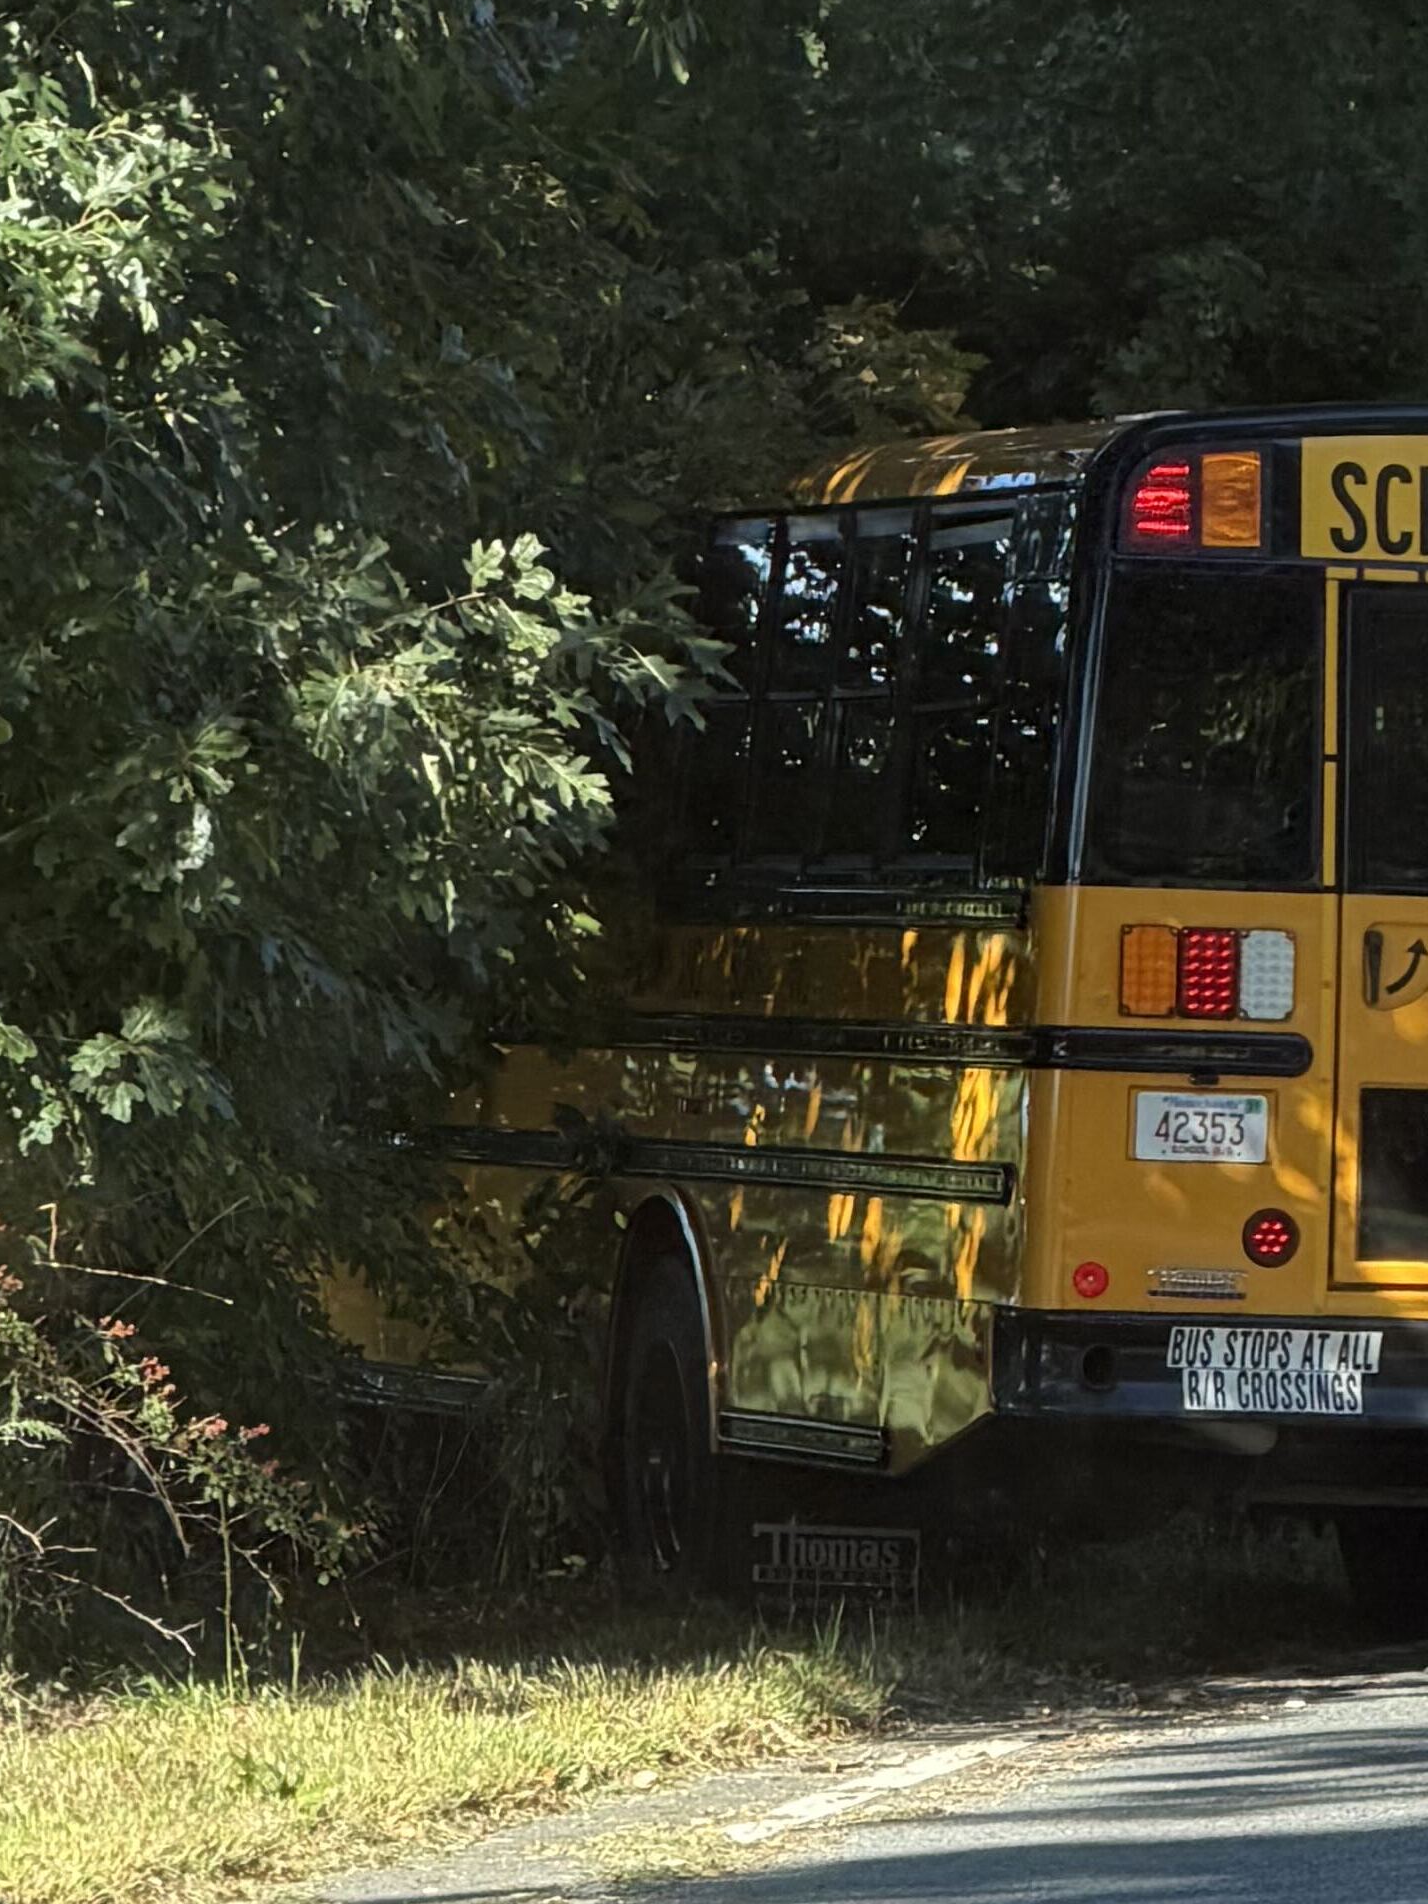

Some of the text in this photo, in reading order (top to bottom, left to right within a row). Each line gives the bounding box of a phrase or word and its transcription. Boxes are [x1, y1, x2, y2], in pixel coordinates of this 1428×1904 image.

[1154, 1110, 1245, 1146] 42353
[1172, 1328, 1374, 1371] BUS STOPS AT ALL
[1187, 1370, 1359, 1411] R/R CROSSINGS
[753, 1522, 908, 1569] Thomas
